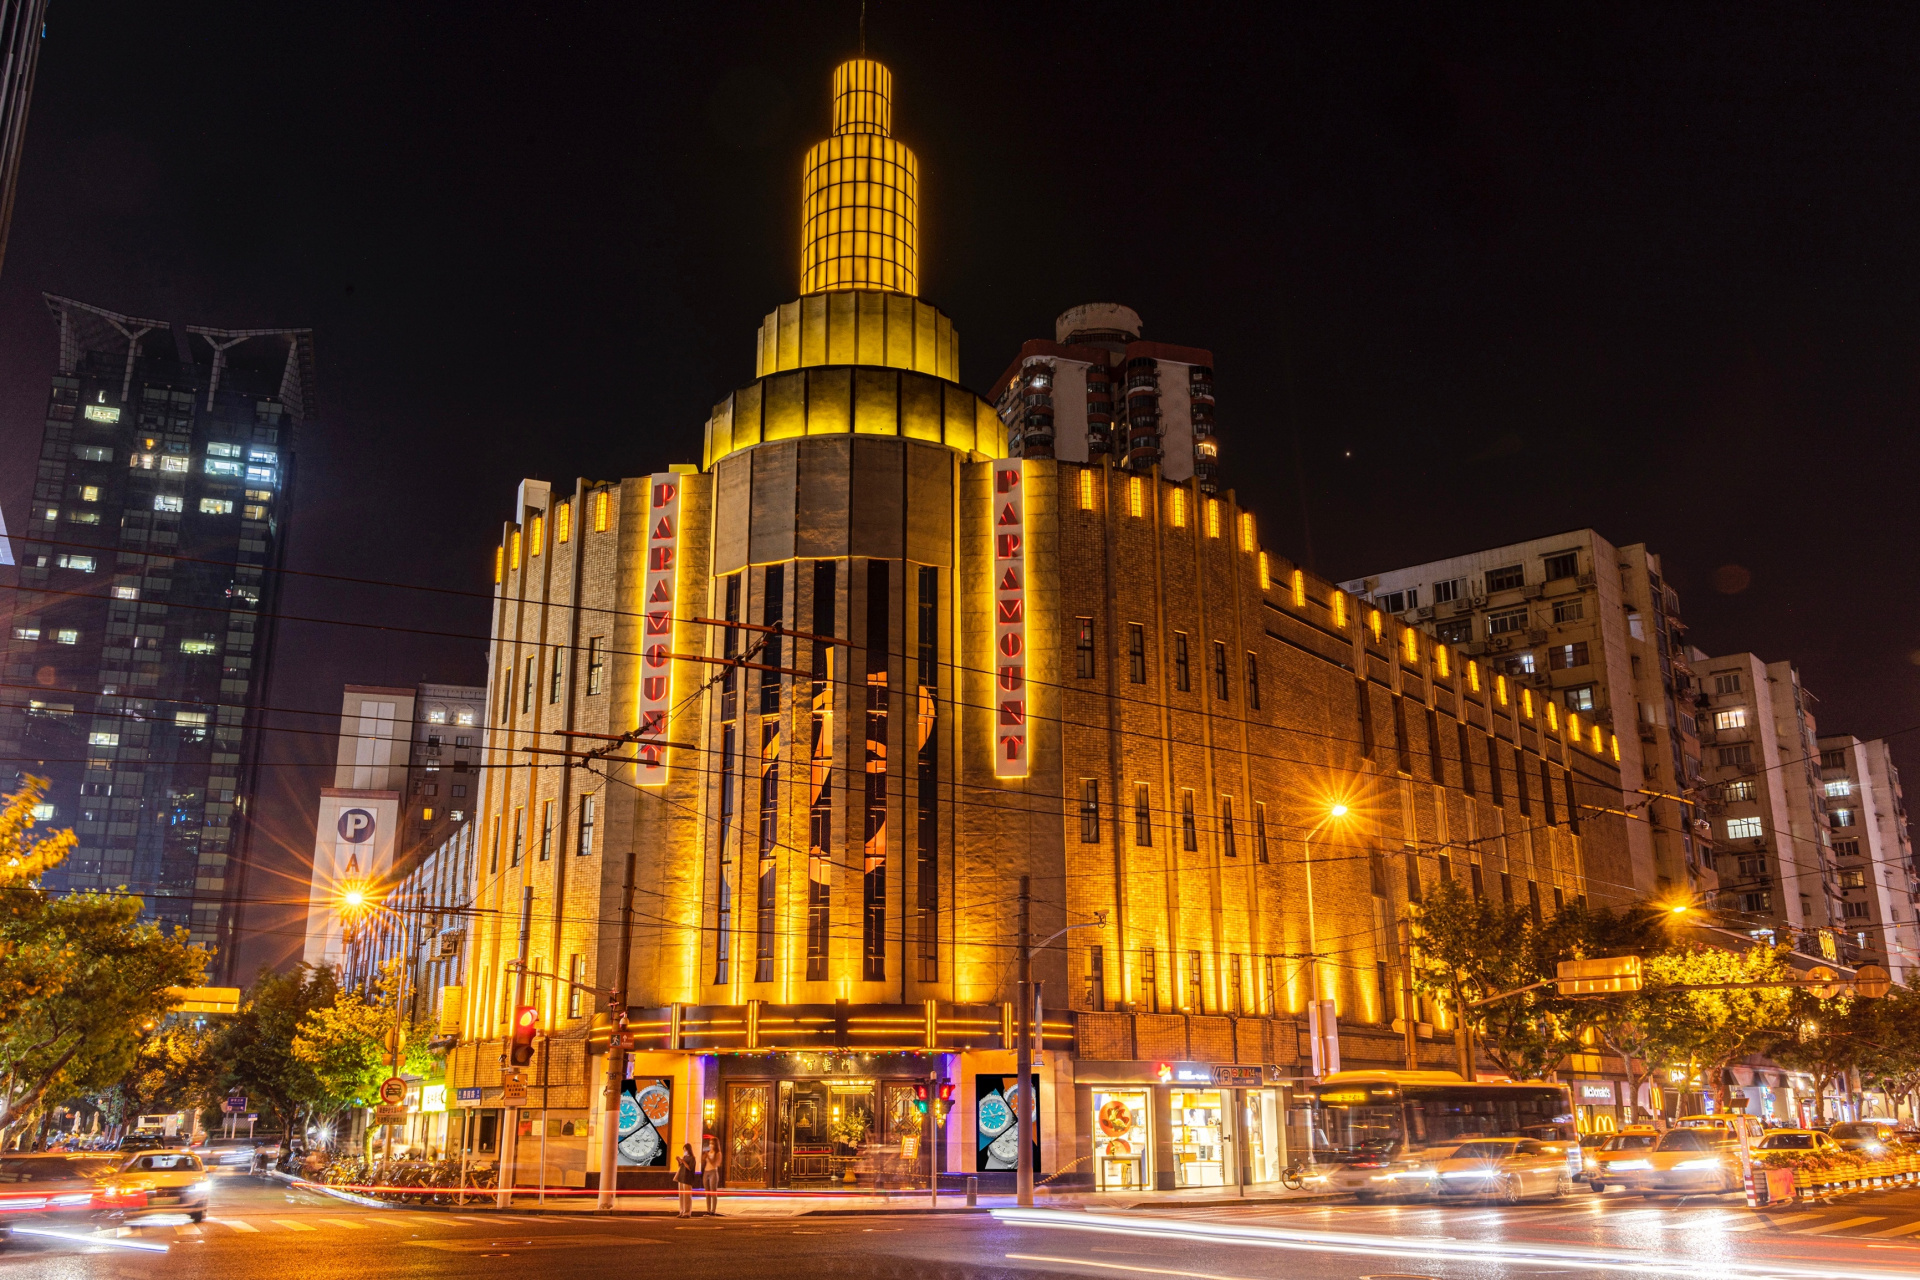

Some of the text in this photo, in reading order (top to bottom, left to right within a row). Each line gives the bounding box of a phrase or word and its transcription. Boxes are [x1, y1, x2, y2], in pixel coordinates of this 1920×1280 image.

[640, 483, 676, 769] PARAMOUNT
[996, 469, 1025, 761] PARAMOUNT
[1584, 1086, 1611, 1098] McDonald's
